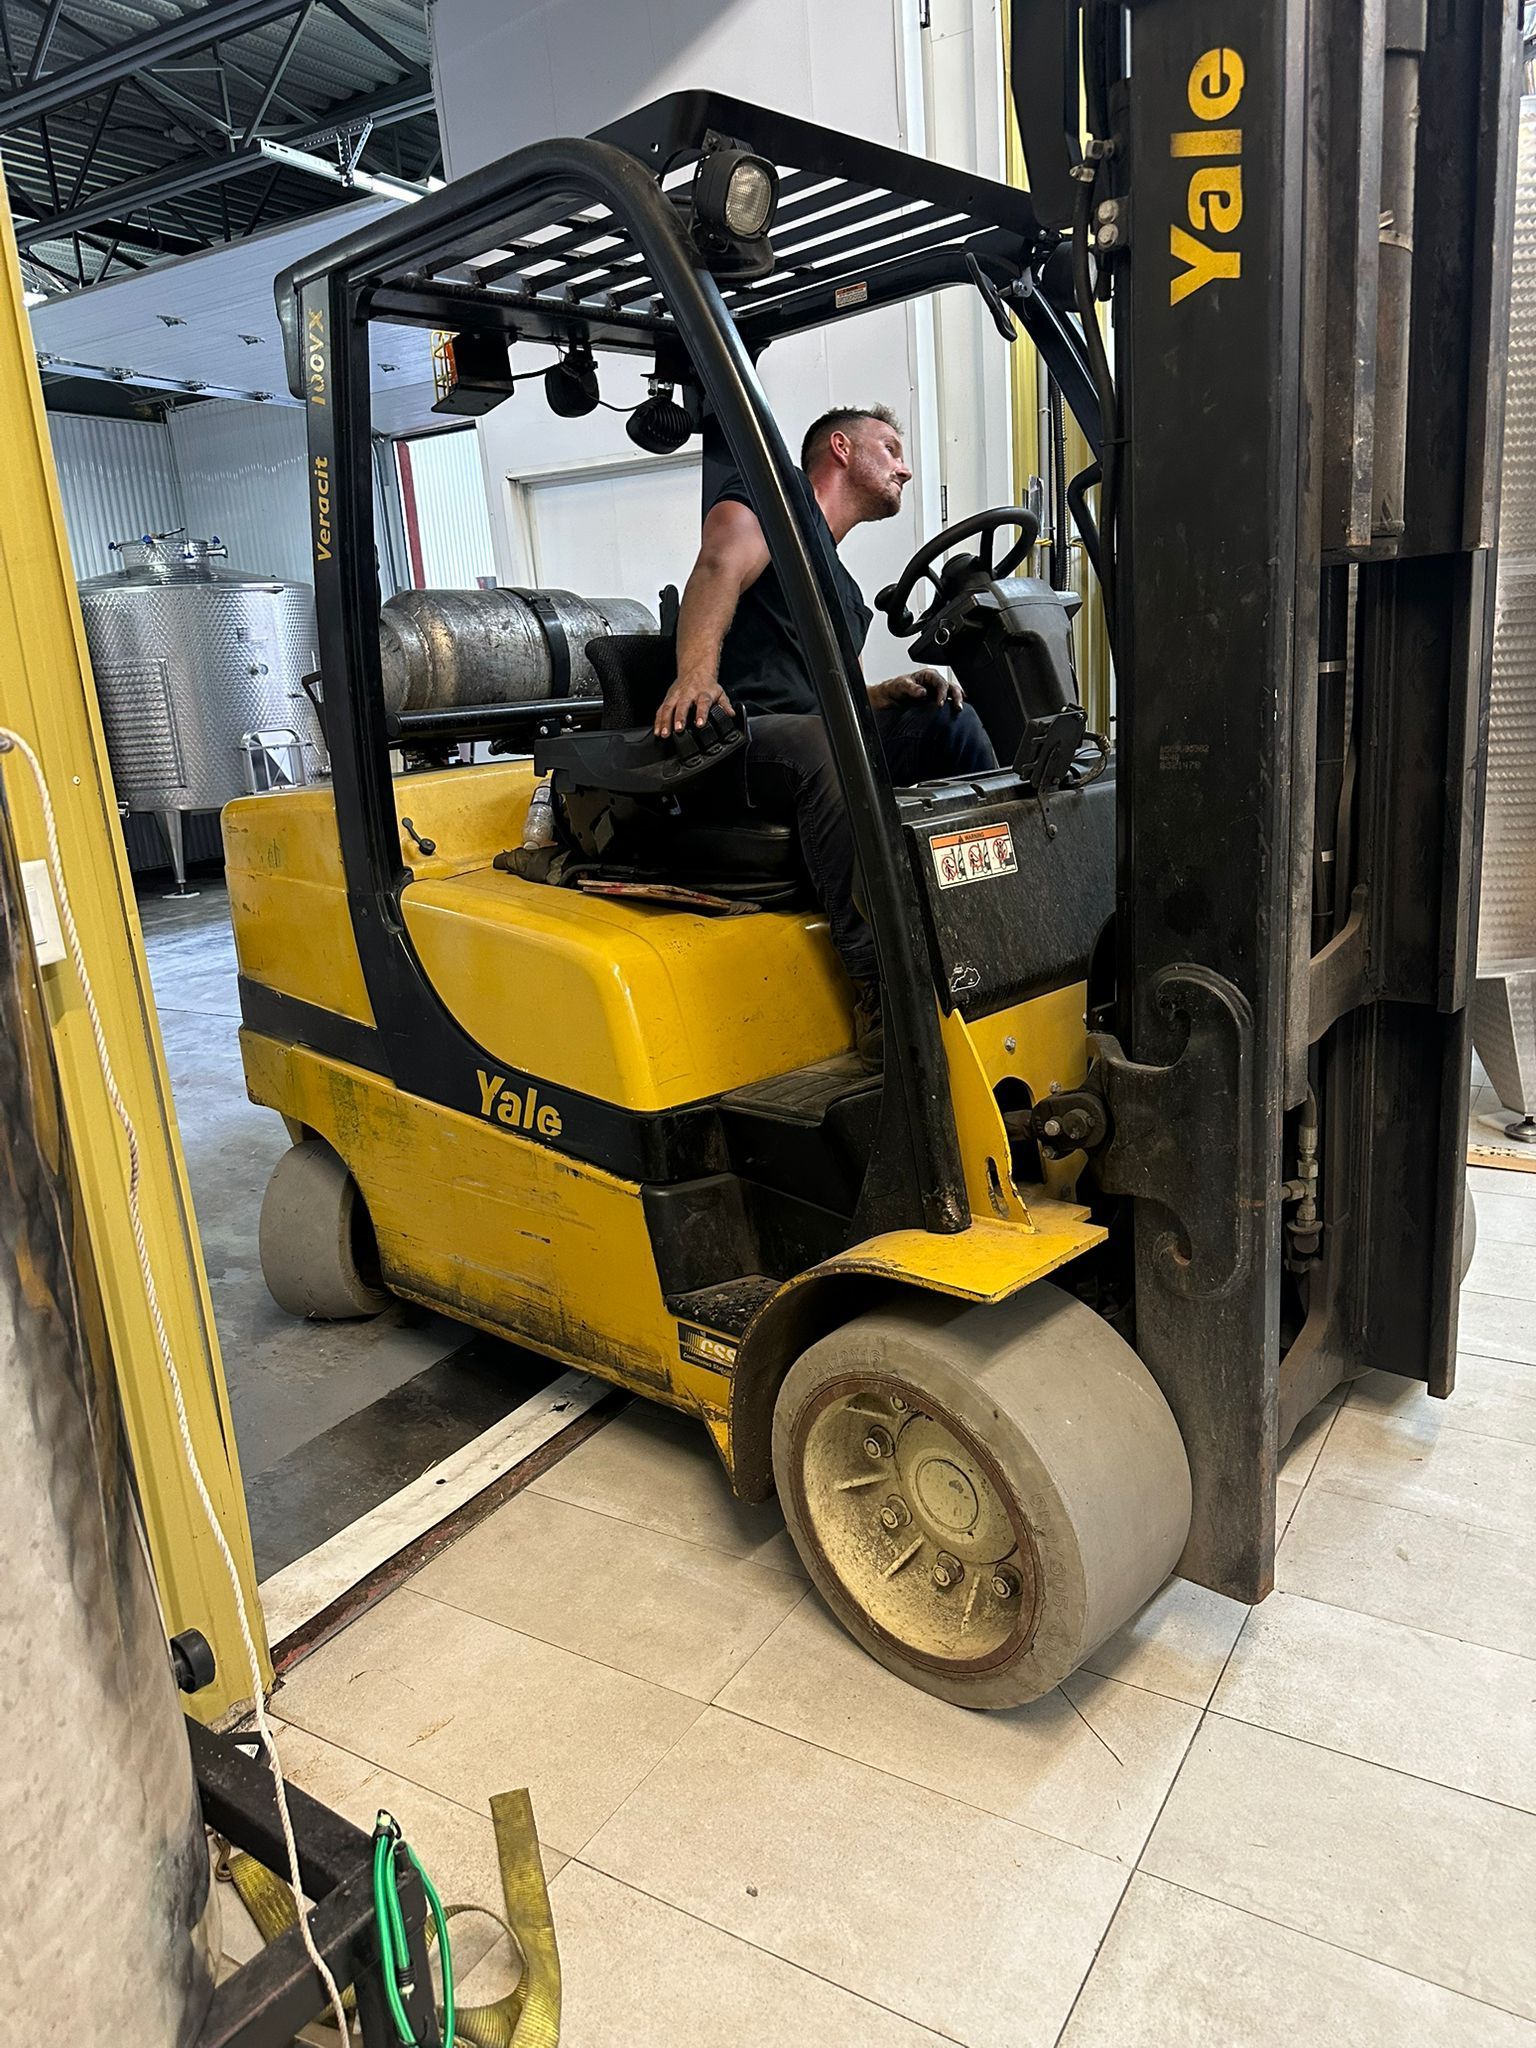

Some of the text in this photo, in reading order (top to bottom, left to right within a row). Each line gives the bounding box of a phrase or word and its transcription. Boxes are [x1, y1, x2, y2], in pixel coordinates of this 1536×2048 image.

[1170, 47, 1245, 306] Yale
[307, 308, 331, 561] Veracit 100VX
[476, 1069, 563, 1137] Yale
